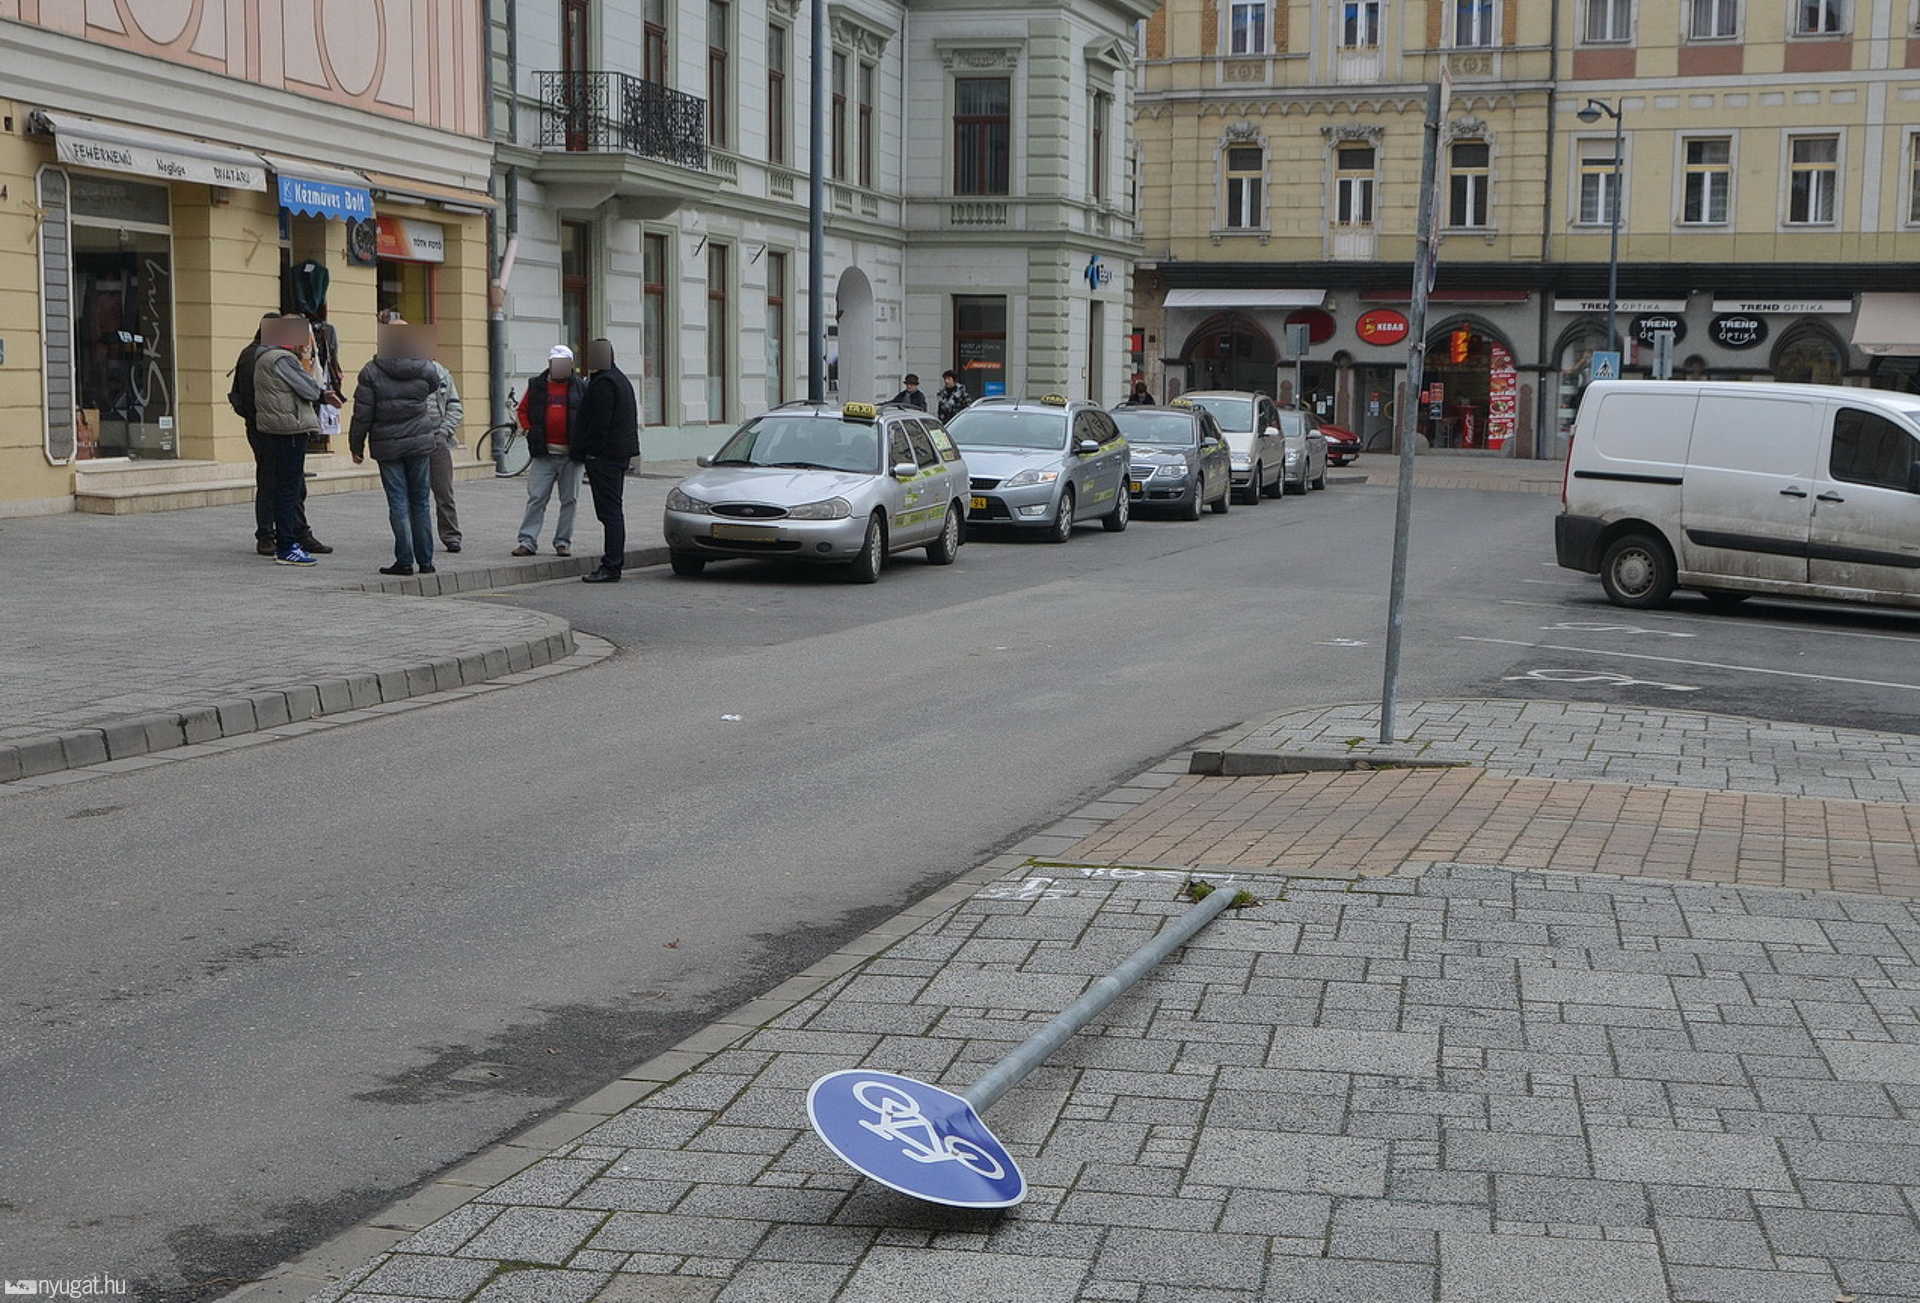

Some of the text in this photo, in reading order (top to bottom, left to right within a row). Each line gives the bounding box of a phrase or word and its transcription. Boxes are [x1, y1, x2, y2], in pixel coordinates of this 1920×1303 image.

[1620, 303, 1661, 311] OPTIKA
[1740, 303, 1825, 312] TREND OPTIKA
[1639, 319, 1678, 329] TREND
[1719, 320, 1758, 329] TREND
[1719, 331, 1757, 341] OPTIKA
[847, 402, 873, 416] TAXI
